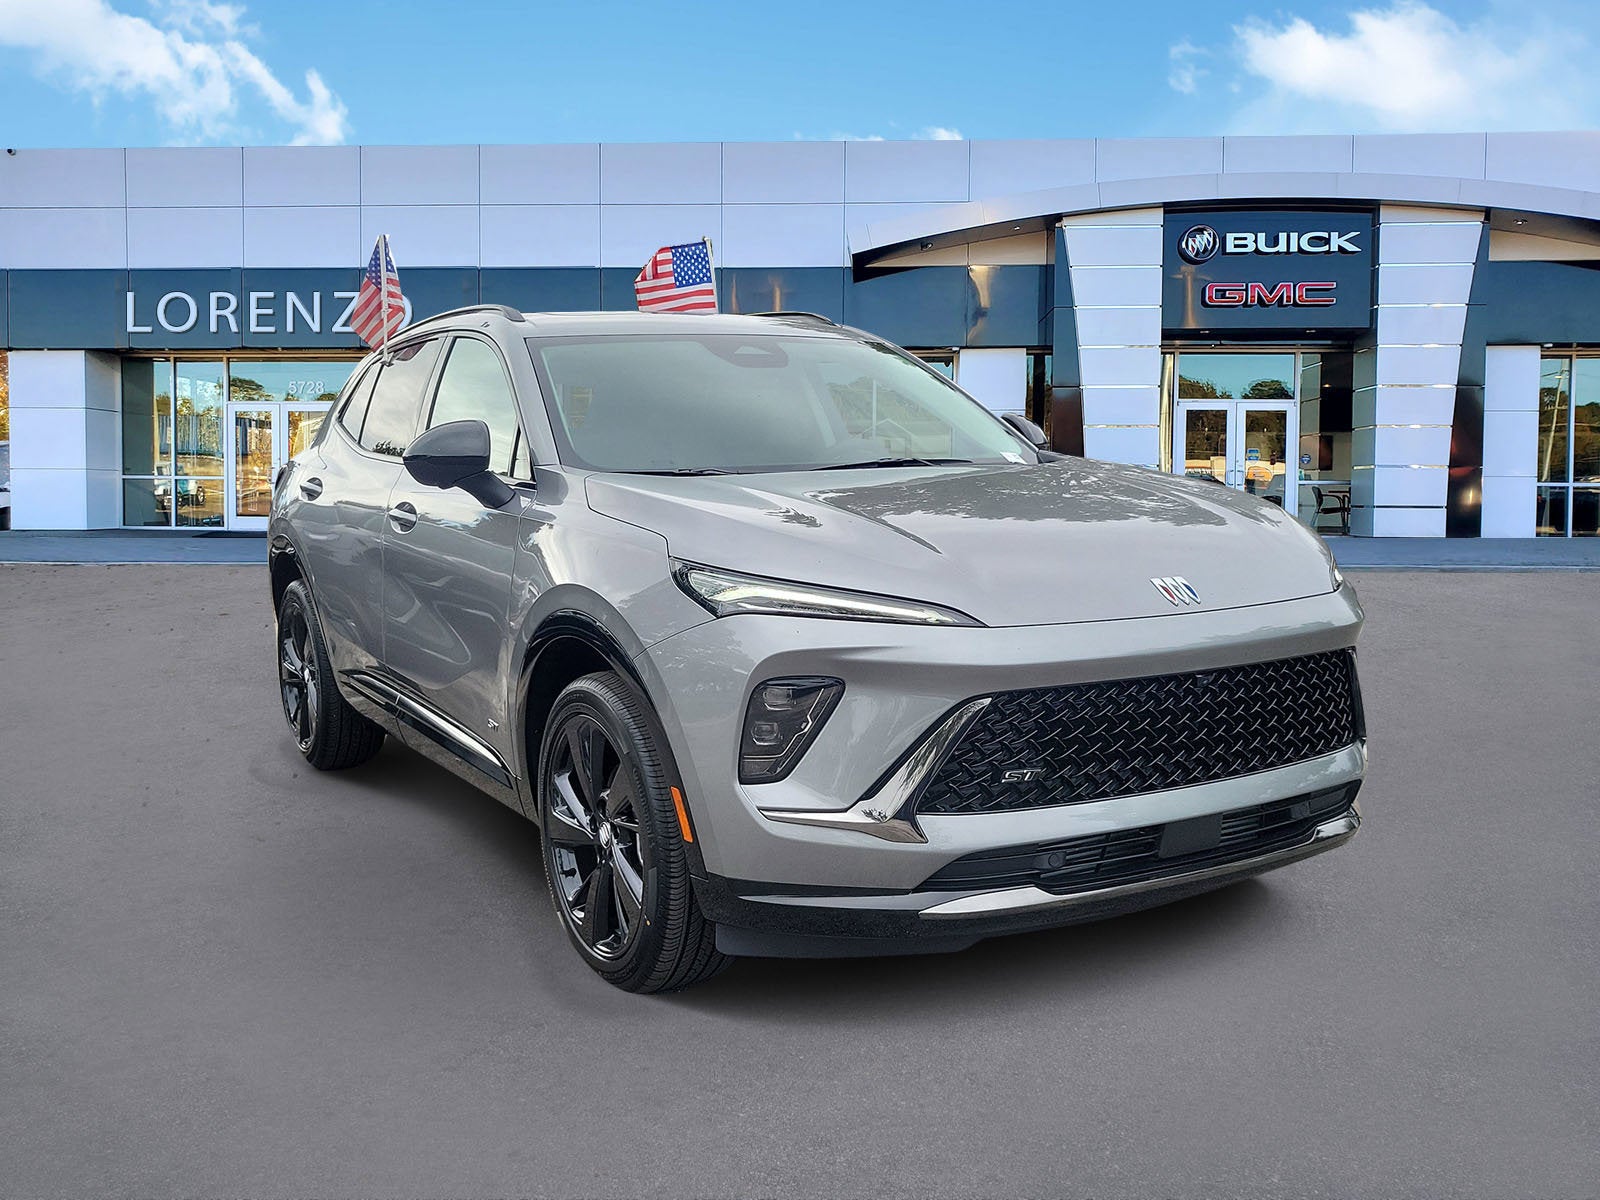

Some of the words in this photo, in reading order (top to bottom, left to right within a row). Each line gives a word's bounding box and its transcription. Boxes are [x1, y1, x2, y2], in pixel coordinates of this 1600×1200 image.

[1225, 231, 1362, 253] BUICK
[1205, 281, 1337, 306] GMC
[288, 381, 325, 394] 5728
[1001, 768, 1042, 783] ST
